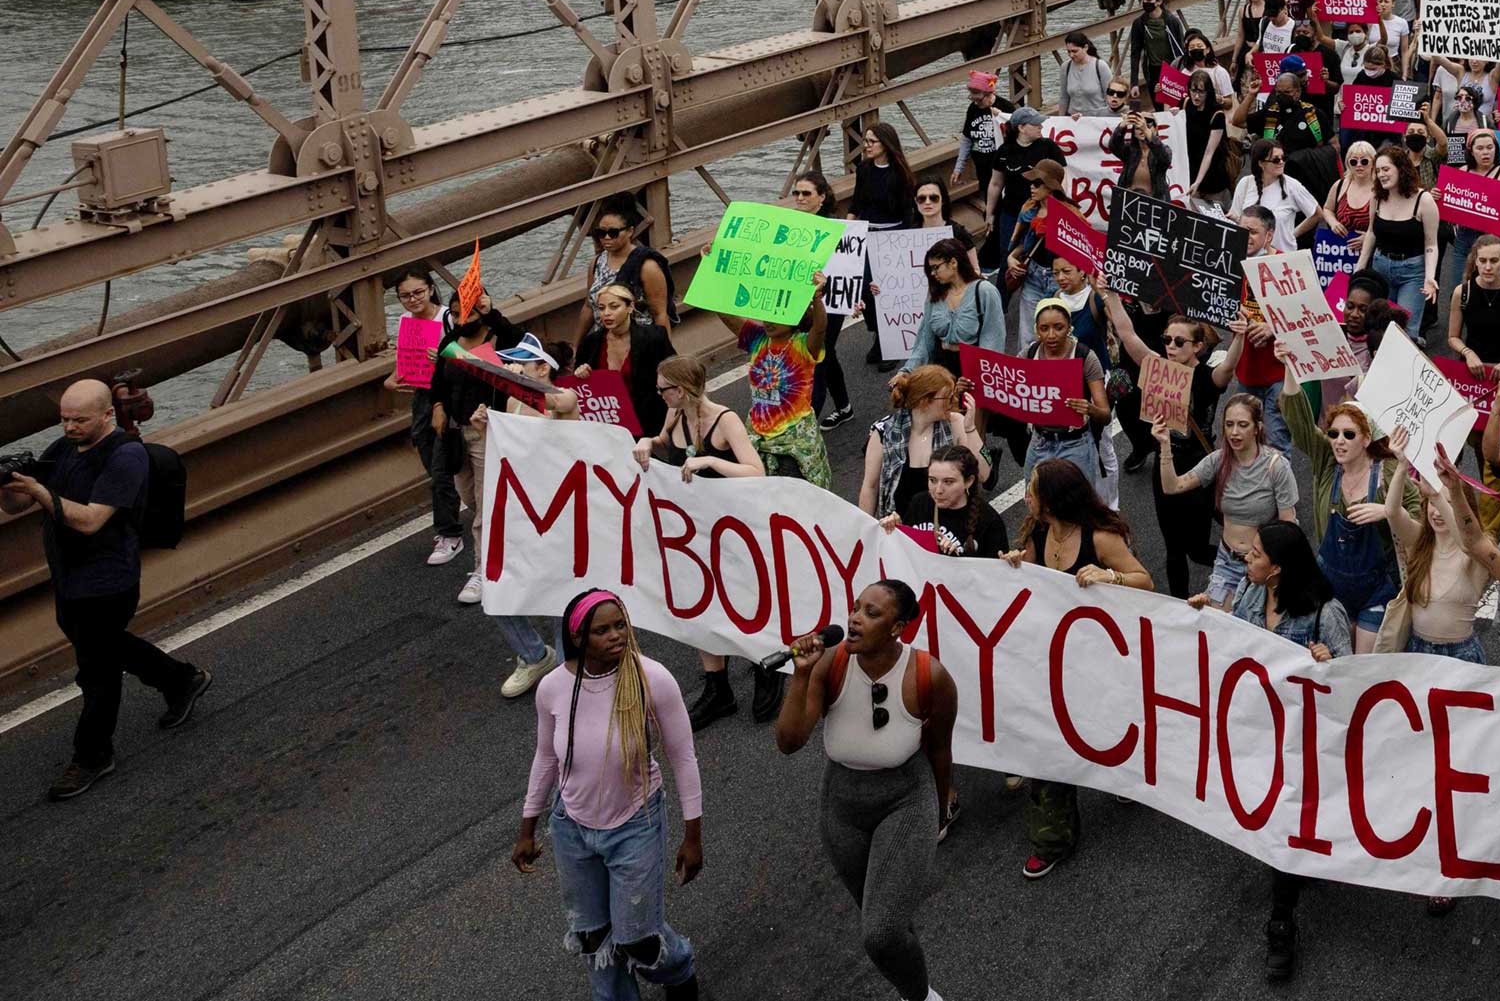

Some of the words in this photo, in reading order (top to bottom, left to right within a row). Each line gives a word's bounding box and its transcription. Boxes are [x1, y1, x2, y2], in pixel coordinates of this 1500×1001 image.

[1325, 6, 1365, 16] BODIES
[1426, 4, 1480, 20] POLITICS
[1483, 6, 1500, 20] IN
[1422, 20, 1441, 33] MY
[1422, 34, 1450, 53] FUCK
[1453, 37, 1461, 55] A
[1161, 84, 1182, 97] Health
[1162, 76, 1185, 92] Abortion
[1395, 86, 1418, 94] STAND
[1355, 92, 1384, 104] BANS
[1391, 101, 1416, 110] BLACK
[1393, 93, 1413, 101] WITH
[1353, 103, 1375, 113] OFF
[1390, 109, 1421, 119] WOMEN
[1444, 183, 1480, 200] Abortion
[1481, 192, 1488, 202] is
[1443, 193, 1473, 209] Health
[1474, 202, 1499, 216] Care.
[1121, 191, 1178, 233] KEEP
[1183, 215, 1238, 249] IT
[723, 216, 770, 243] HER
[772, 224, 831, 253] BODY
[1057, 217, 1094, 253] Abortion
[1095, 247, 1104, 259] is
[835, 236, 867, 257] ANCY
[1119, 224, 1169, 253] SAFE
[1181, 241, 1243, 279] LEGAL
[714, 249, 753, 277] HER
[755, 254, 825, 286] CHOICE
[877, 253, 893, 269] IS
[896, 254, 906, 270] A
[1104, 261, 1126, 278] OUR
[1106, 248, 1127, 266] OUR
[1128, 256, 1155, 278] BODY
[877, 273, 906, 290] YOU
[1104, 273, 1141, 298] CHOICE
[1191, 273, 1228, 297] SAFE
[1257, 262, 1307, 298] Anti
[734, 283, 792, 316] DUH!!
[879, 293, 921, 311] CARE
[884, 311, 924, 327] WOM
[1187, 306, 1220, 324] HUMAN
[1265, 303, 1335, 335] Abortion
[979, 358, 1027, 384] BANS
[1288, 345, 1359, 378] Pro-Death
[980, 371, 1015, 394] OFF
[1014, 383, 1062, 401] OUR
[1419, 363, 1444, 393] KEEP
[568, 383, 593, 399] NS
[983, 385, 1054, 415] BODIES
[1414, 383, 1434, 409] YOUR
[586, 396, 621, 411] OUR
[1404, 398, 1427, 421] LAWS
[1408, 419, 1421, 435] MY
[486, 455, 640, 588] MY
[648, 487, 864, 647] BODY
